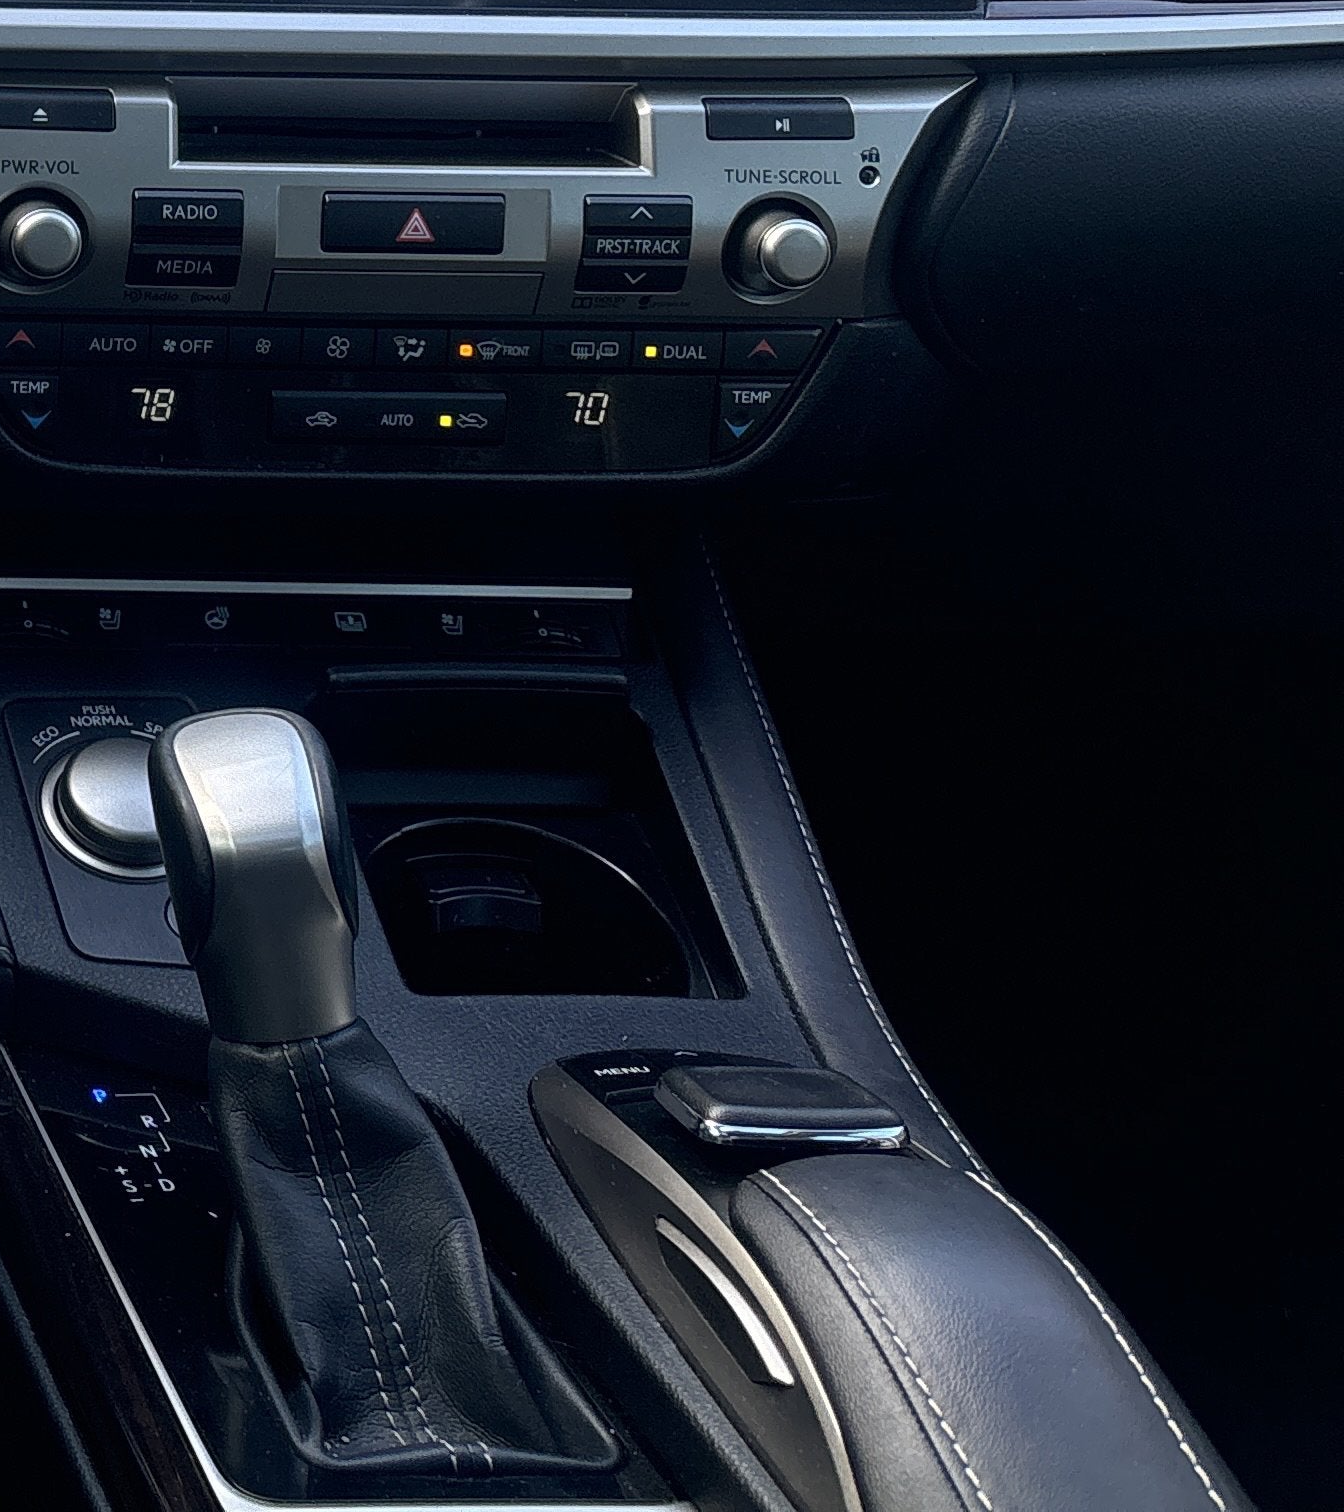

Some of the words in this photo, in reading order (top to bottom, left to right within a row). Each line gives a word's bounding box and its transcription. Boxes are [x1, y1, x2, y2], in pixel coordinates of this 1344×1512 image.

[162, 204, 218, 221] RADIO
[155, 259, 214, 276] MEDIA
[88, 337, 138, 354] AUTO
[179, 338, 214, 355] OFF
[502, 344, 530, 358] FRONT
[663, 345, 707, 360] DUAL
[10, 380, 50, 395] TEMP
[732, 389, 772, 405] TEMP
[130, 388, 175, 422] 78
[566, 391, 610, 426] 70
[380, 413, 415, 427] AUTO
[81, 705, 116, 715] PUSH
[69, 715, 134, 728] NORMAL
[31, 725, 60, 748] ECO
[593, 1065, 651, 1077] MENU
[92, 1088, 107, 1103] P
[139, 1114, 159, 1128] R
[138, 1144, 159, 1158] N
[121, 1179, 138, 1193] S
[157, 1178, 176, 1192] D
